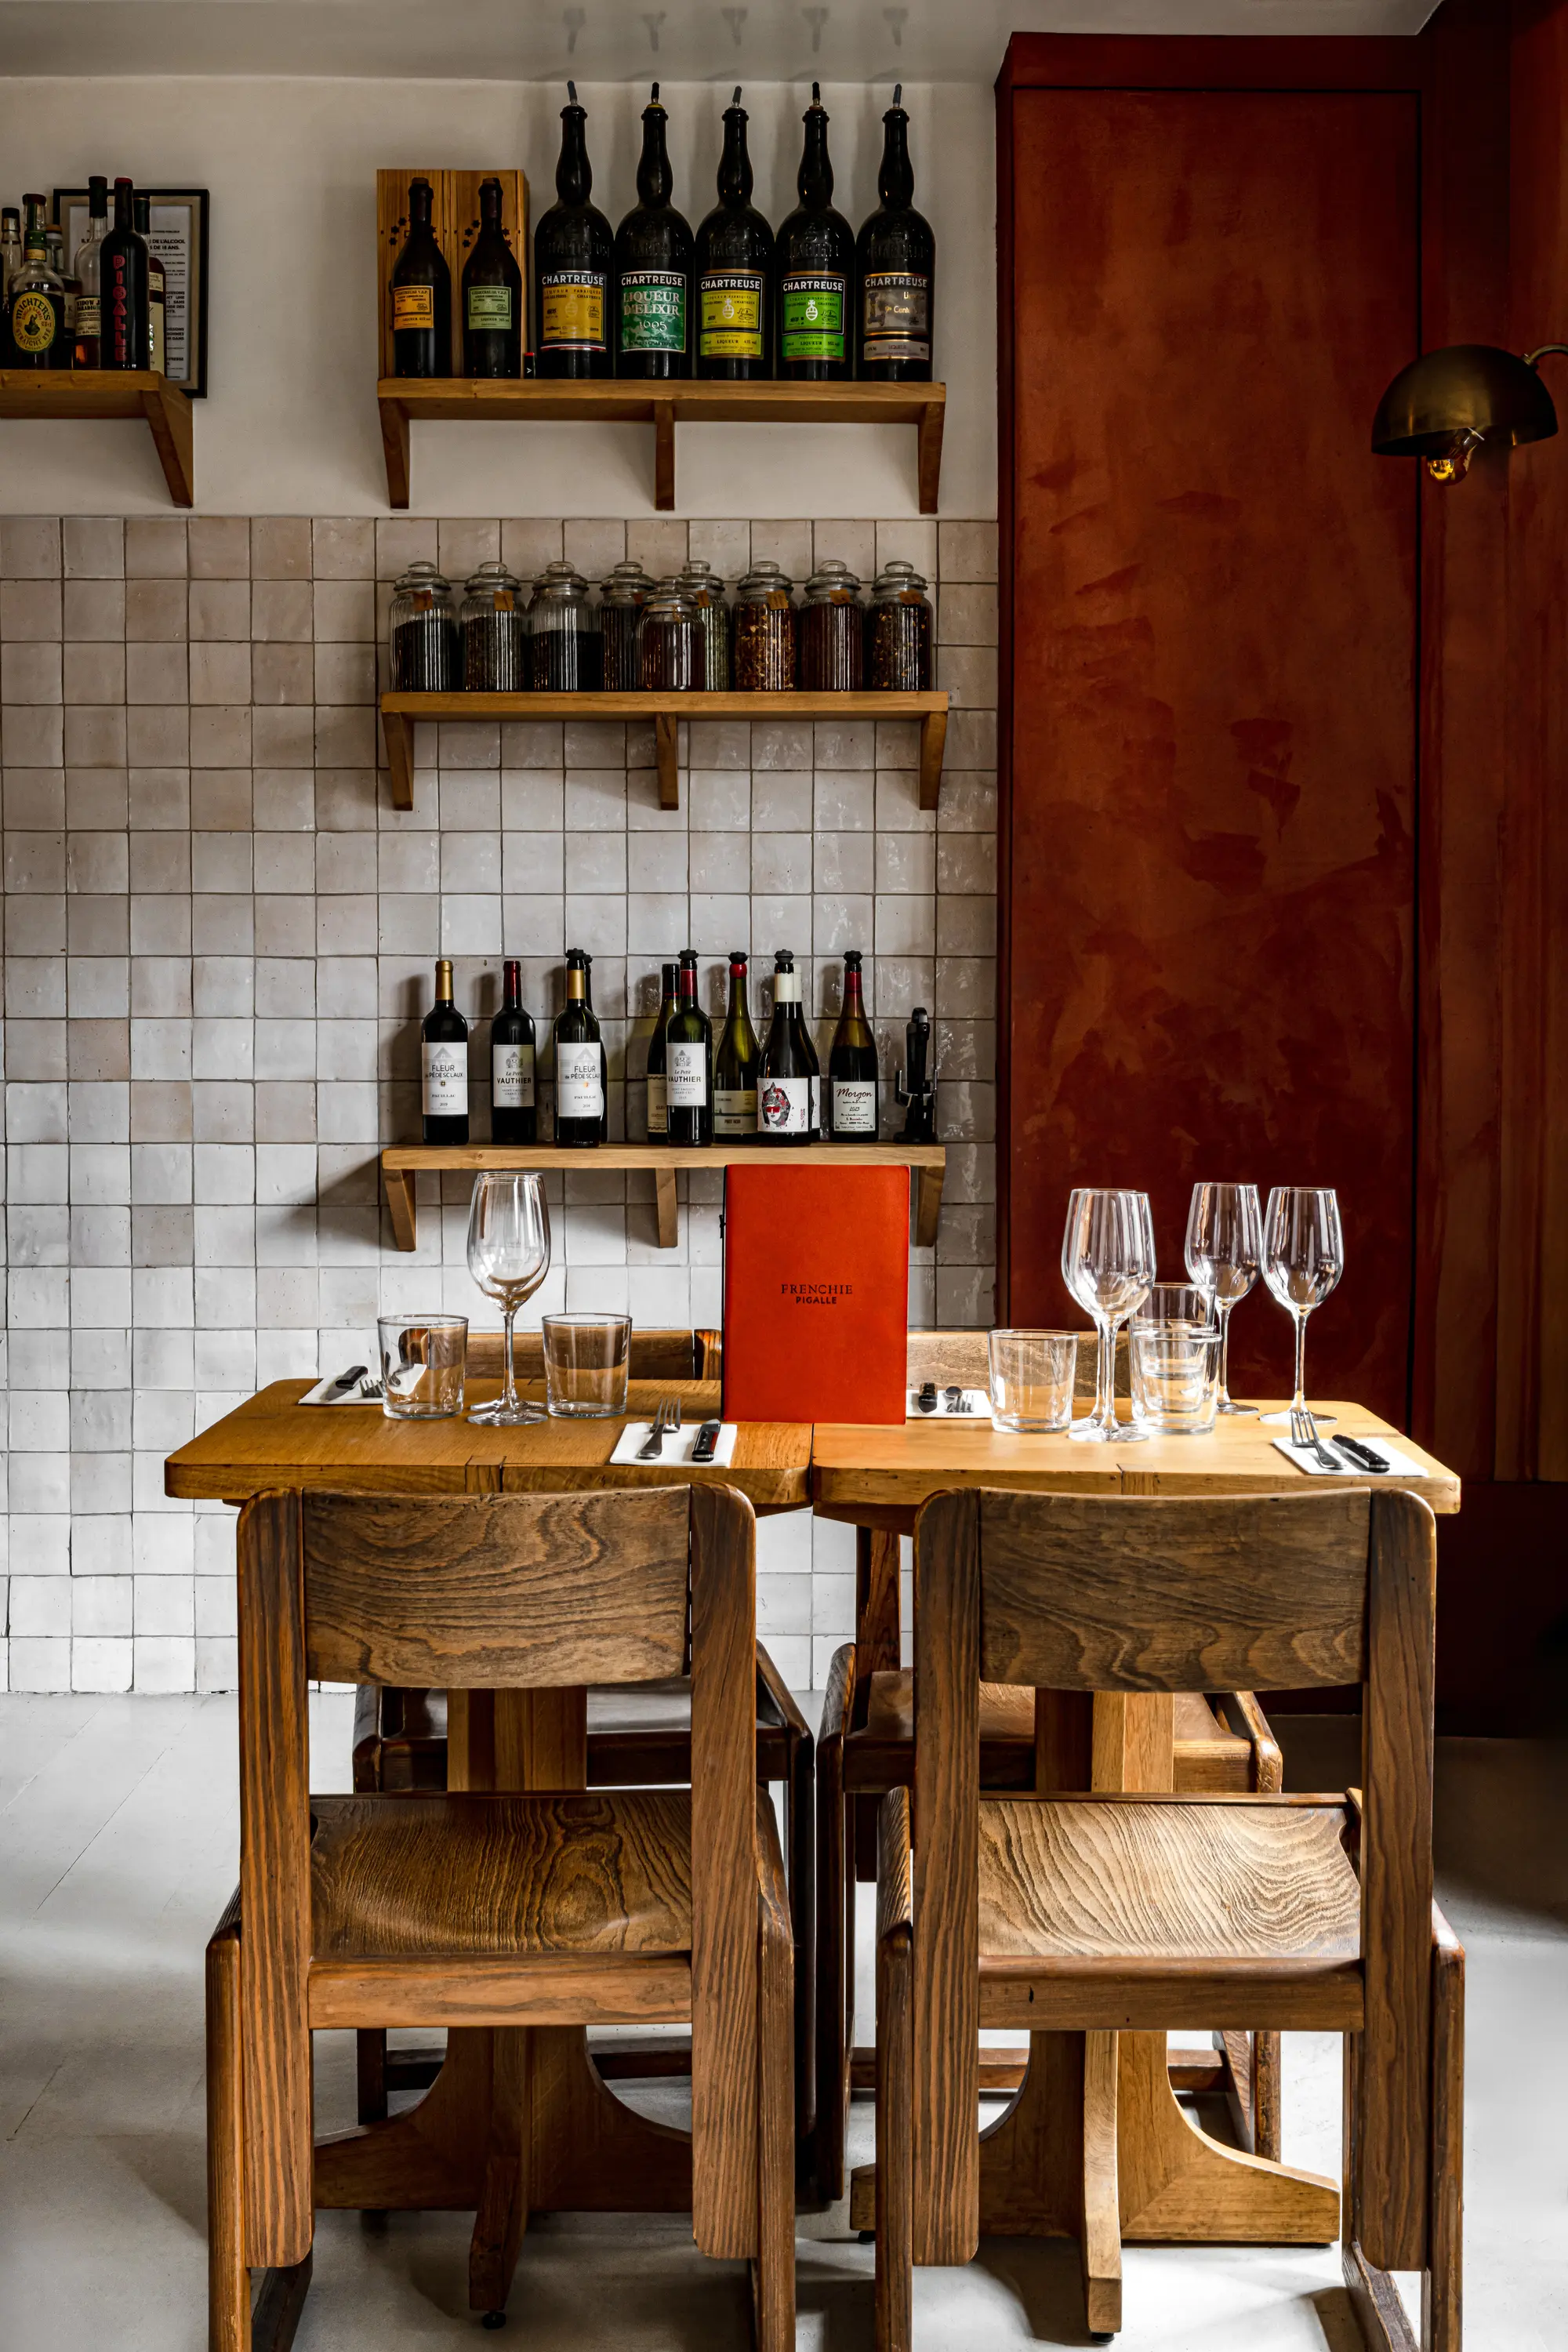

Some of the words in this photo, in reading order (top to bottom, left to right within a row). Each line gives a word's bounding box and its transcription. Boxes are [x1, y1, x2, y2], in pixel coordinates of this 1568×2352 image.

[542, 274, 604, 285] CHARTREUSE
[621, 275, 683, 286] CHARTREUSE
[701, 278, 760, 289] CHARTREUSE
[865, 276, 927, 288] CHARTREUSE
[782, 281, 843, 292] CHARTREUSE
[623, 291, 681, 303] LIQUEUR
[113, 255, 128, 361] PIGALLE
[623, 303, 681, 316] D'ELIXIR
[639, 320, 667, 332] 1605
[836, 1087, 873, 1102] Morgon
[781, 1284, 853, 1294] FRENCHIE
[796, 1296, 837, 1305] PIGALLE
